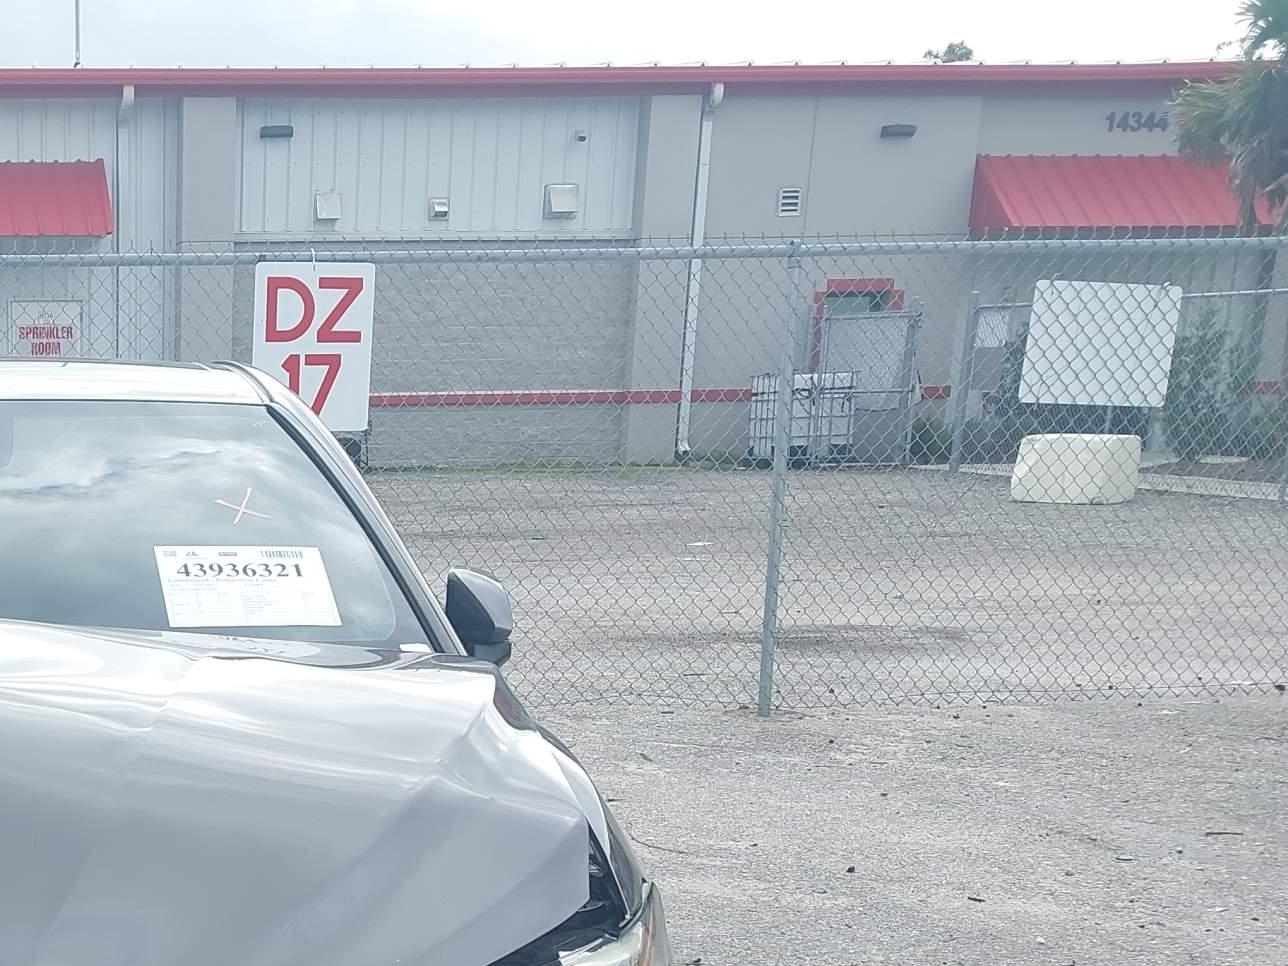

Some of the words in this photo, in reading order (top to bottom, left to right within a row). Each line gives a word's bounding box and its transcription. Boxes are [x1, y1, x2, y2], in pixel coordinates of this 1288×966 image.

[1105, 111, 1169, 133] 14344
[265, 276, 364, 344] DZ
[18, 326, 73, 340] SPRINKLER
[31, 341, 61, 356] ROOM
[280, 353, 342, 417] 17
[176, 562, 304, 578] 43936321
